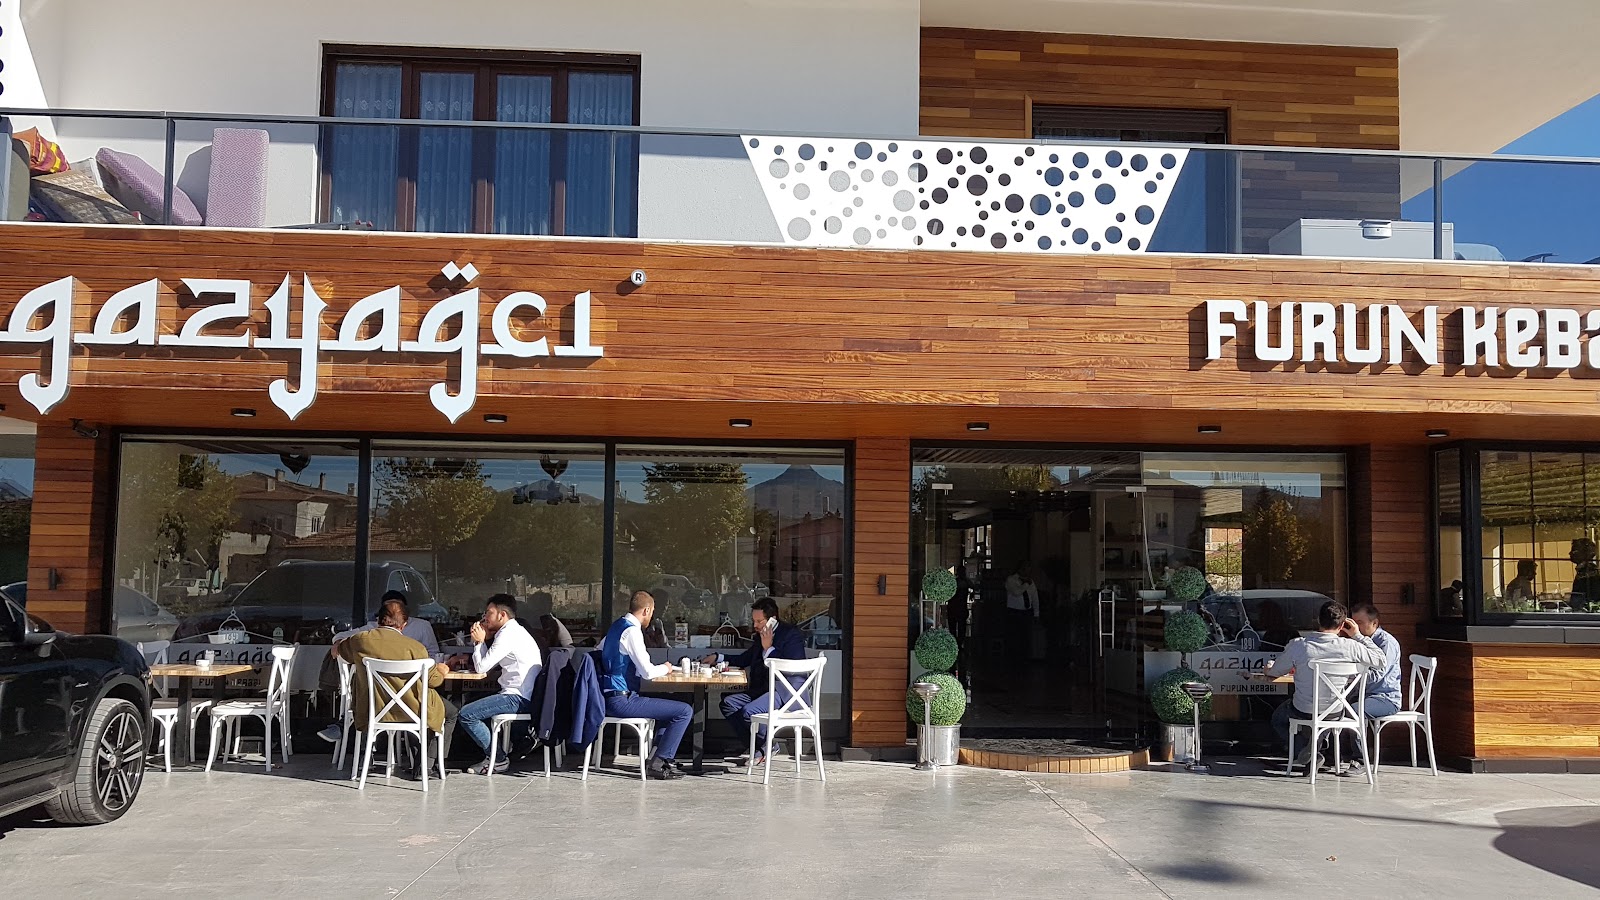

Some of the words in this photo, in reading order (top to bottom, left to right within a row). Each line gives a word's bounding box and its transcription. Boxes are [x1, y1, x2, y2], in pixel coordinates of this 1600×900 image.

[1204, 299, 1440, 367] FURUN
[720, 633, 735, 646] 1891
[1241, 637, 1255, 650] 1891
